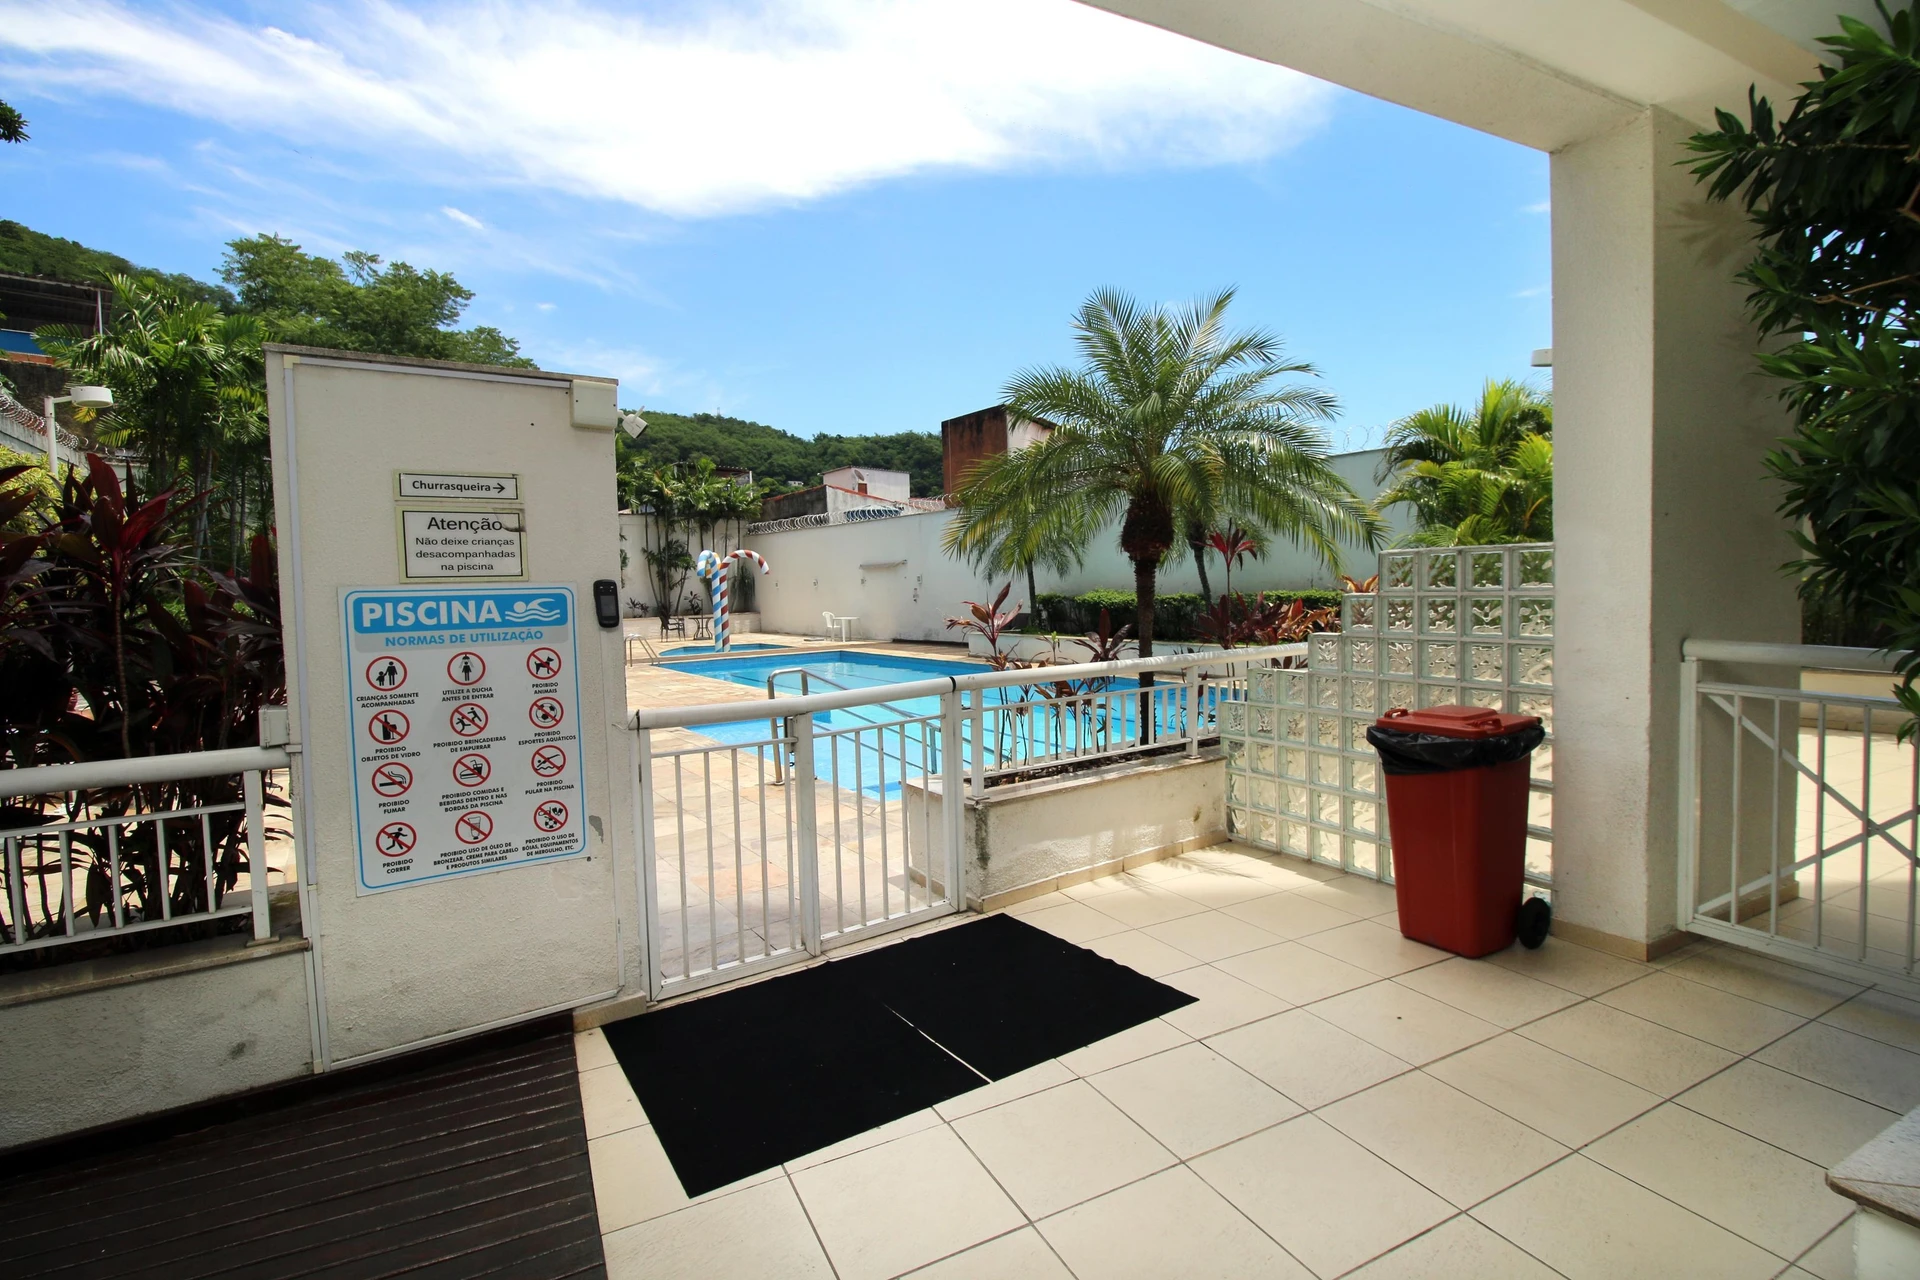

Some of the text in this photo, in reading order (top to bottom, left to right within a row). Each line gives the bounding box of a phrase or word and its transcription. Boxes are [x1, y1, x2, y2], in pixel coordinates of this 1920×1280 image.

[412, 480, 491, 492] Churrasqueira
[427, 517, 503, 534] Atenção
[416, 537, 514, 547] Não deixe crianças
[415, 550, 515, 559] desacompanhadas
[457, 563, 494, 572] piscina
[362, 600, 502, 627] PISCINA
[385, 629, 544, 647] NORMAS DE UTILIZAÇÃO
[361, 700, 415, 708] ACOMPANHADAS
[465, 736, 506, 744] BRINCADEIRAS
[375, 746, 406, 754] PROIBIDO
[460, 744, 491, 752] EMPURRAR
[379, 800, 410, 808] PROIBIDO
[540, 838, 578, 848] EQUIPAMENTOS
[434, 855, 464, 866] BRONZEAR,
[484, 850, 498, 858] PARA
[440, 850, 467, 858] PROIBIDO
[383, 859, 413, 868] PROIBIDO
[451, 860, 480, 869] PRODUTOS
[481, 855, 507, 864] SIMILARES
[386, 866, 410, 874] CORRER
